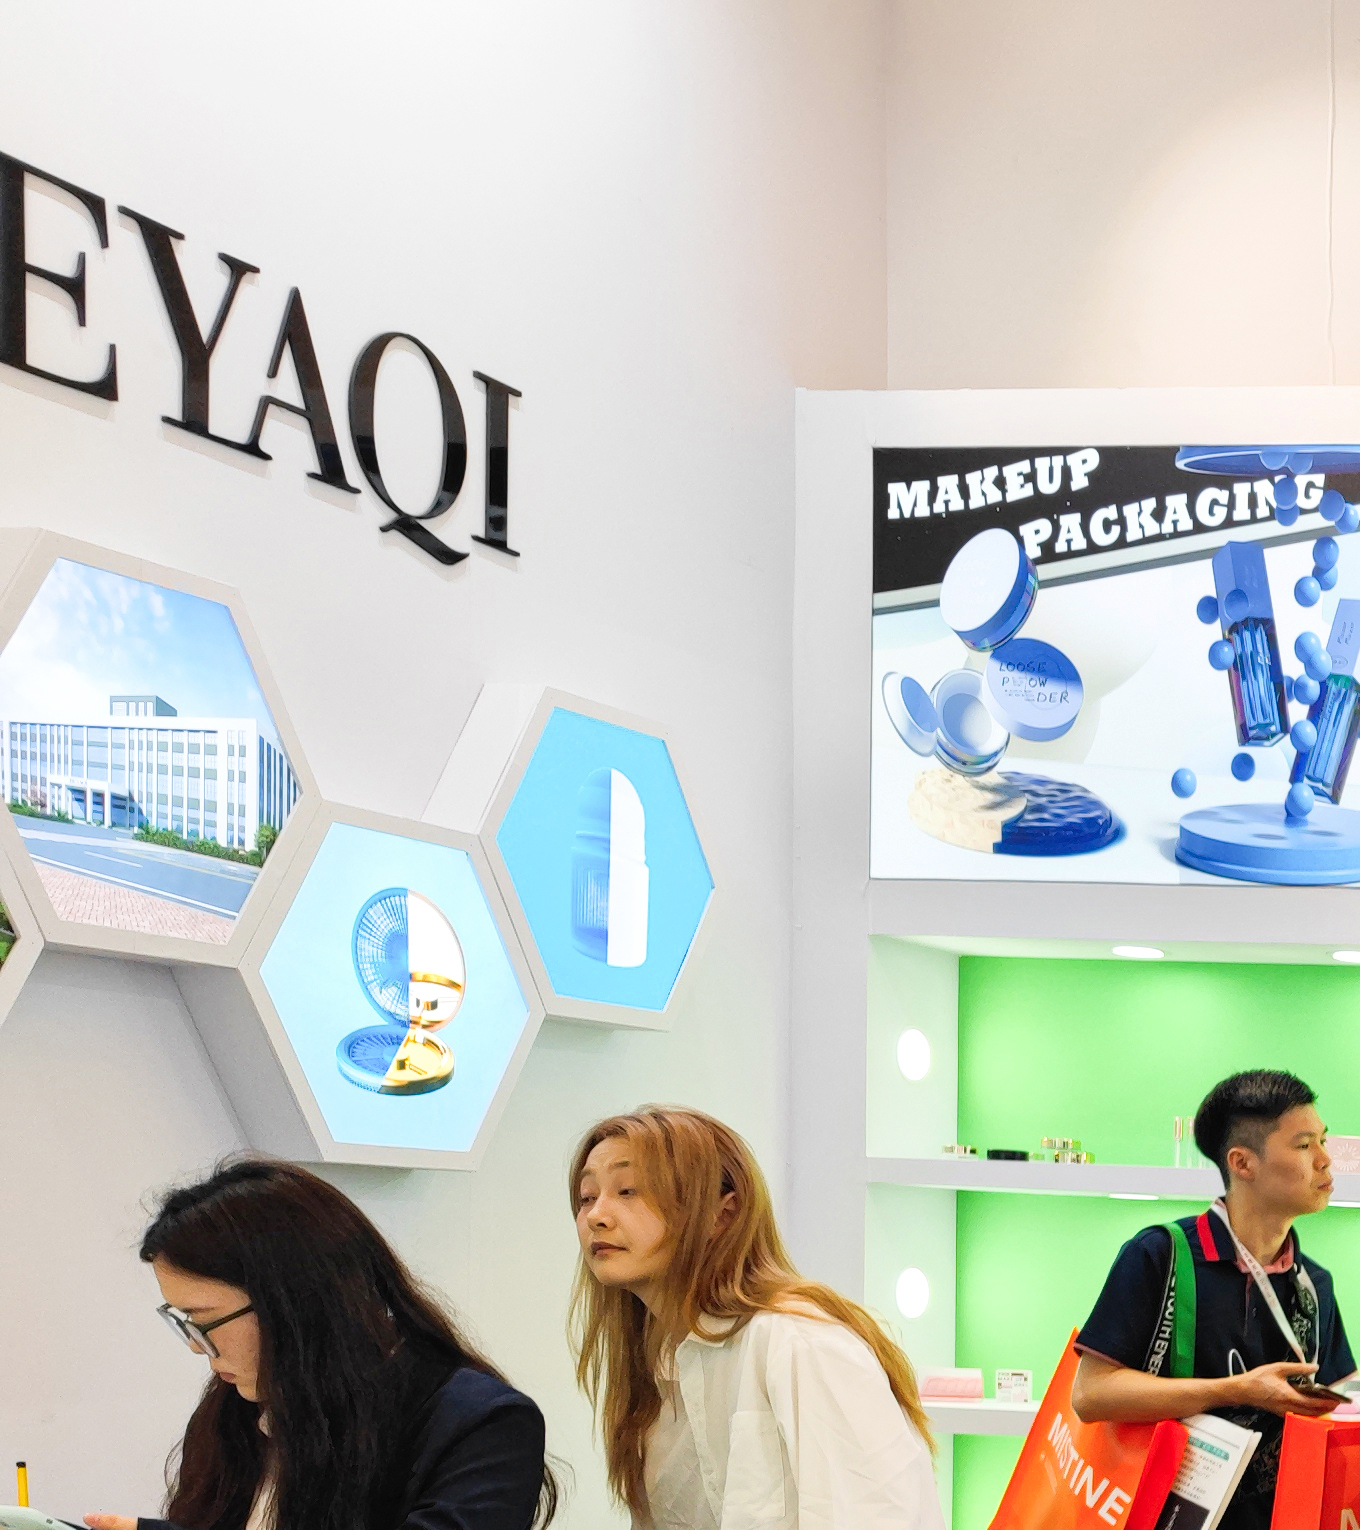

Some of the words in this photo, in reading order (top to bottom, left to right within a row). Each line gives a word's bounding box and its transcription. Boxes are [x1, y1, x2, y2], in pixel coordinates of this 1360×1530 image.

[887, 447, 1101, 520] MAKEUP
[998, 660, 1047, 673] LOOSE
[1047, 1411, 1133, 1527] MISTINE
